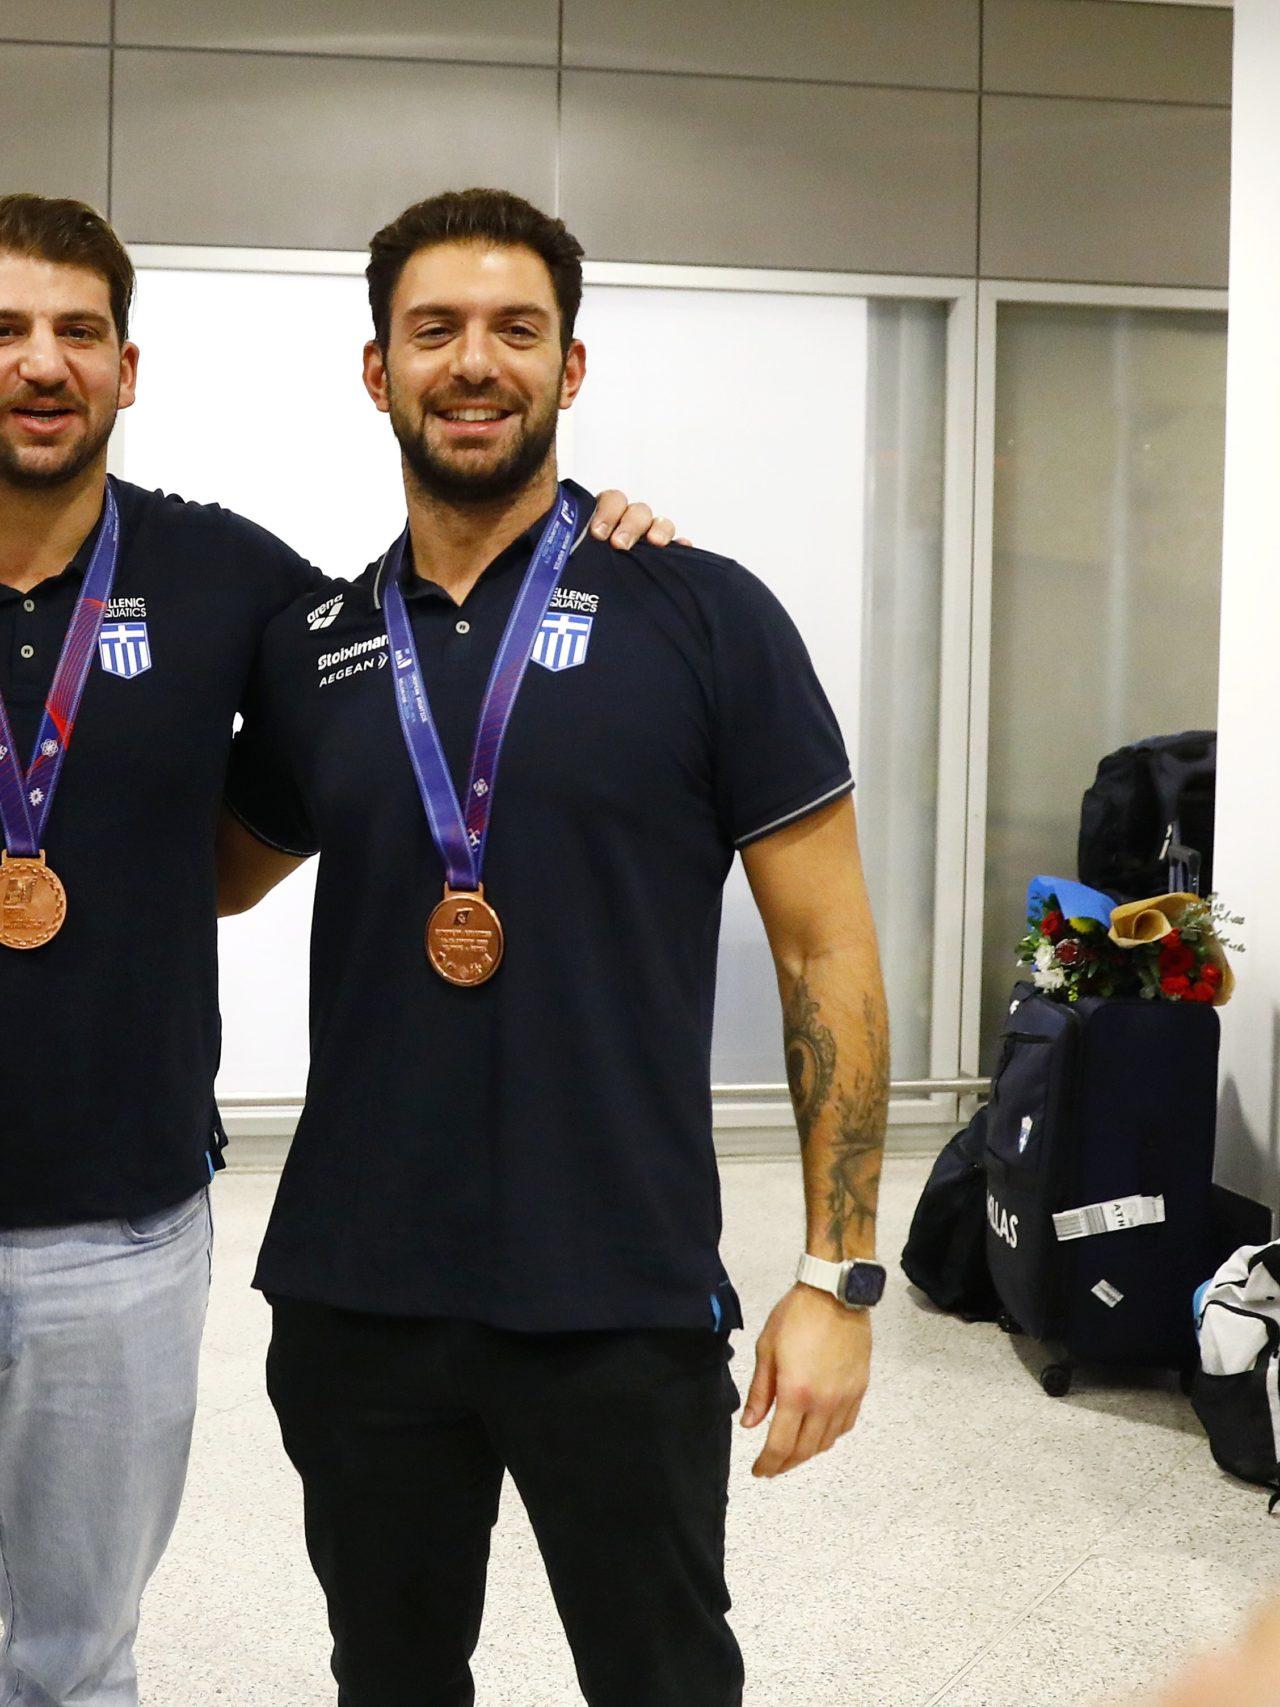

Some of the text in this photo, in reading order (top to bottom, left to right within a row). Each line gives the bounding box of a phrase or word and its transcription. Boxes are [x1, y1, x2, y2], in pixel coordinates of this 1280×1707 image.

[108, 597, 146, 609] LLENIC
[552, 587, 600, 604] LLENIC
[103, 607, 147, 618] QUATICS
[306, 593, 344, 624] arena
[549, 597, 598, 613] QUATICS
[319, 658, 375, 688] AEGEAN
[1113, 1203, 1126, 1227] ATH
